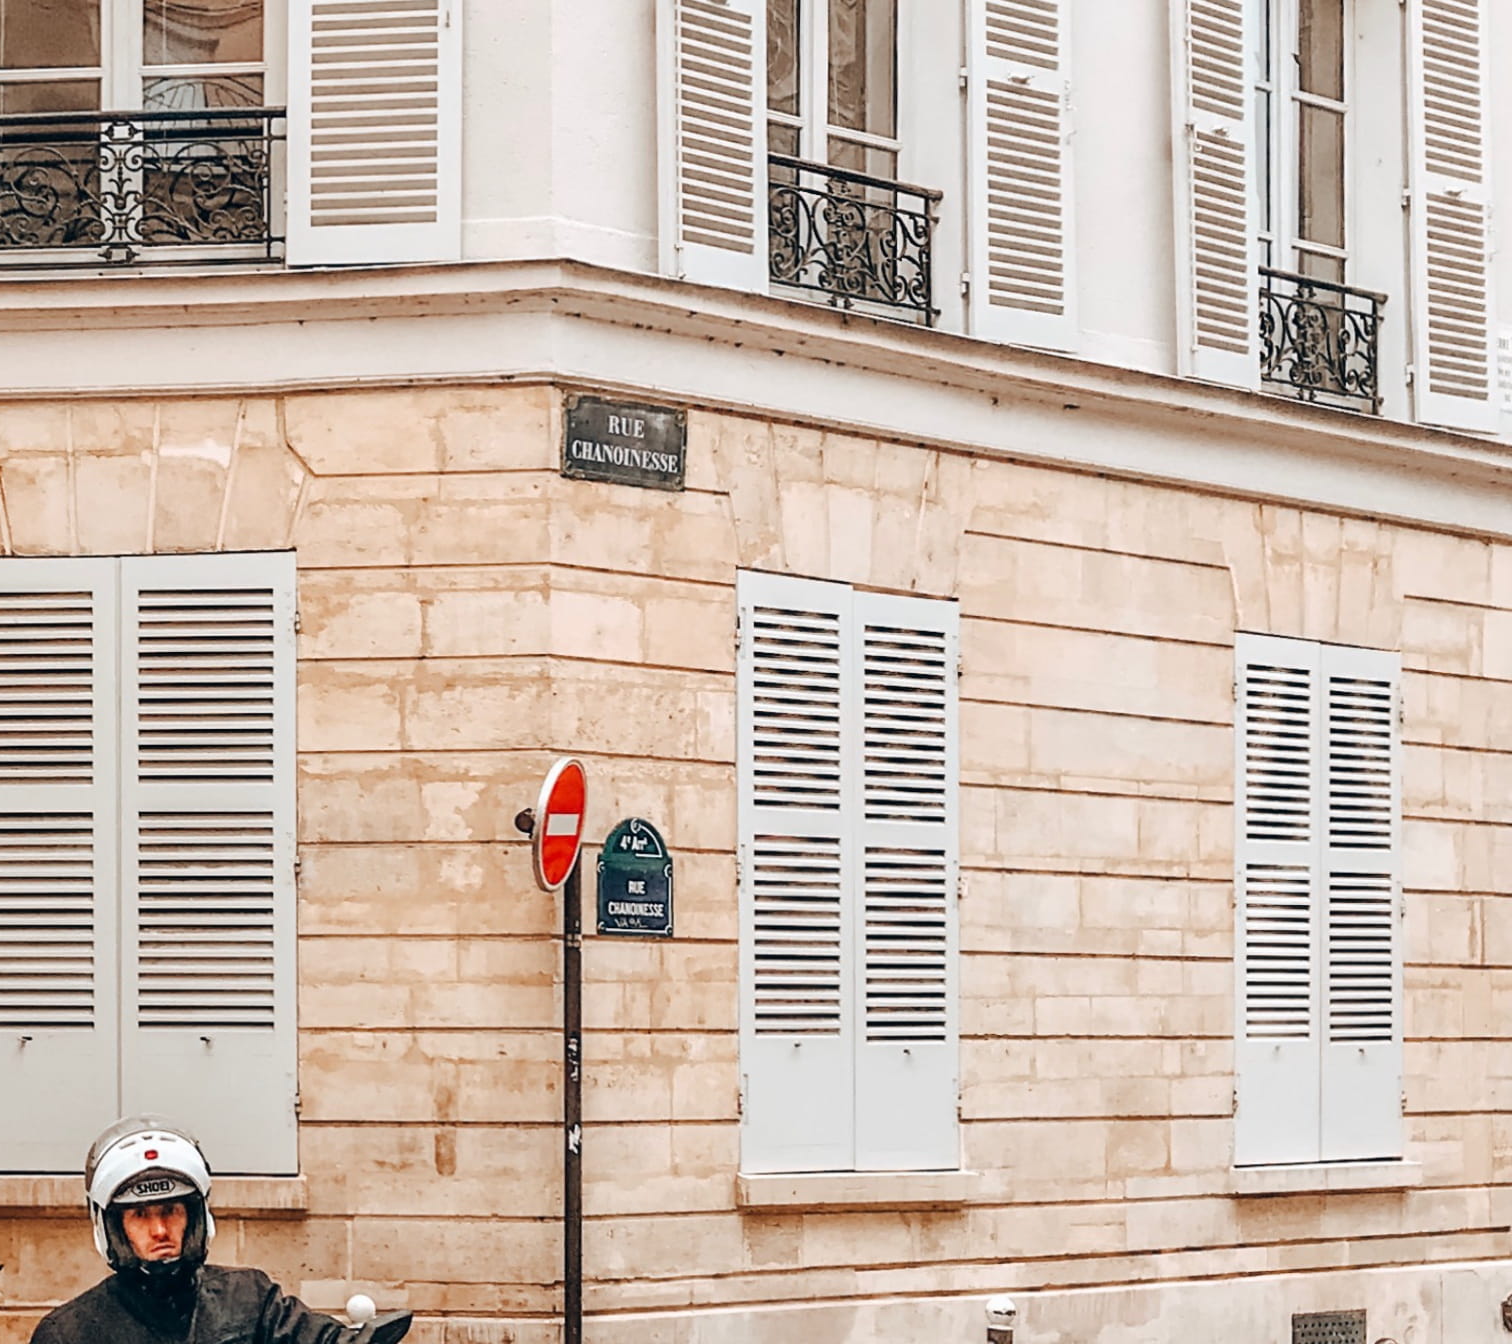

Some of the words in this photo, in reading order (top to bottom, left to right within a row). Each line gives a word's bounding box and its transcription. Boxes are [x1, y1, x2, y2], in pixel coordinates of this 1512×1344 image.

[608, 415, 645, 439] RUE
[572, 440, 678, 473] CHANOINESSE
[628, 880, 646, 894] RUE
[608, 901, 665, 918] CHANOINESSE
[137, 1181, 170, 1194] SHOEI
